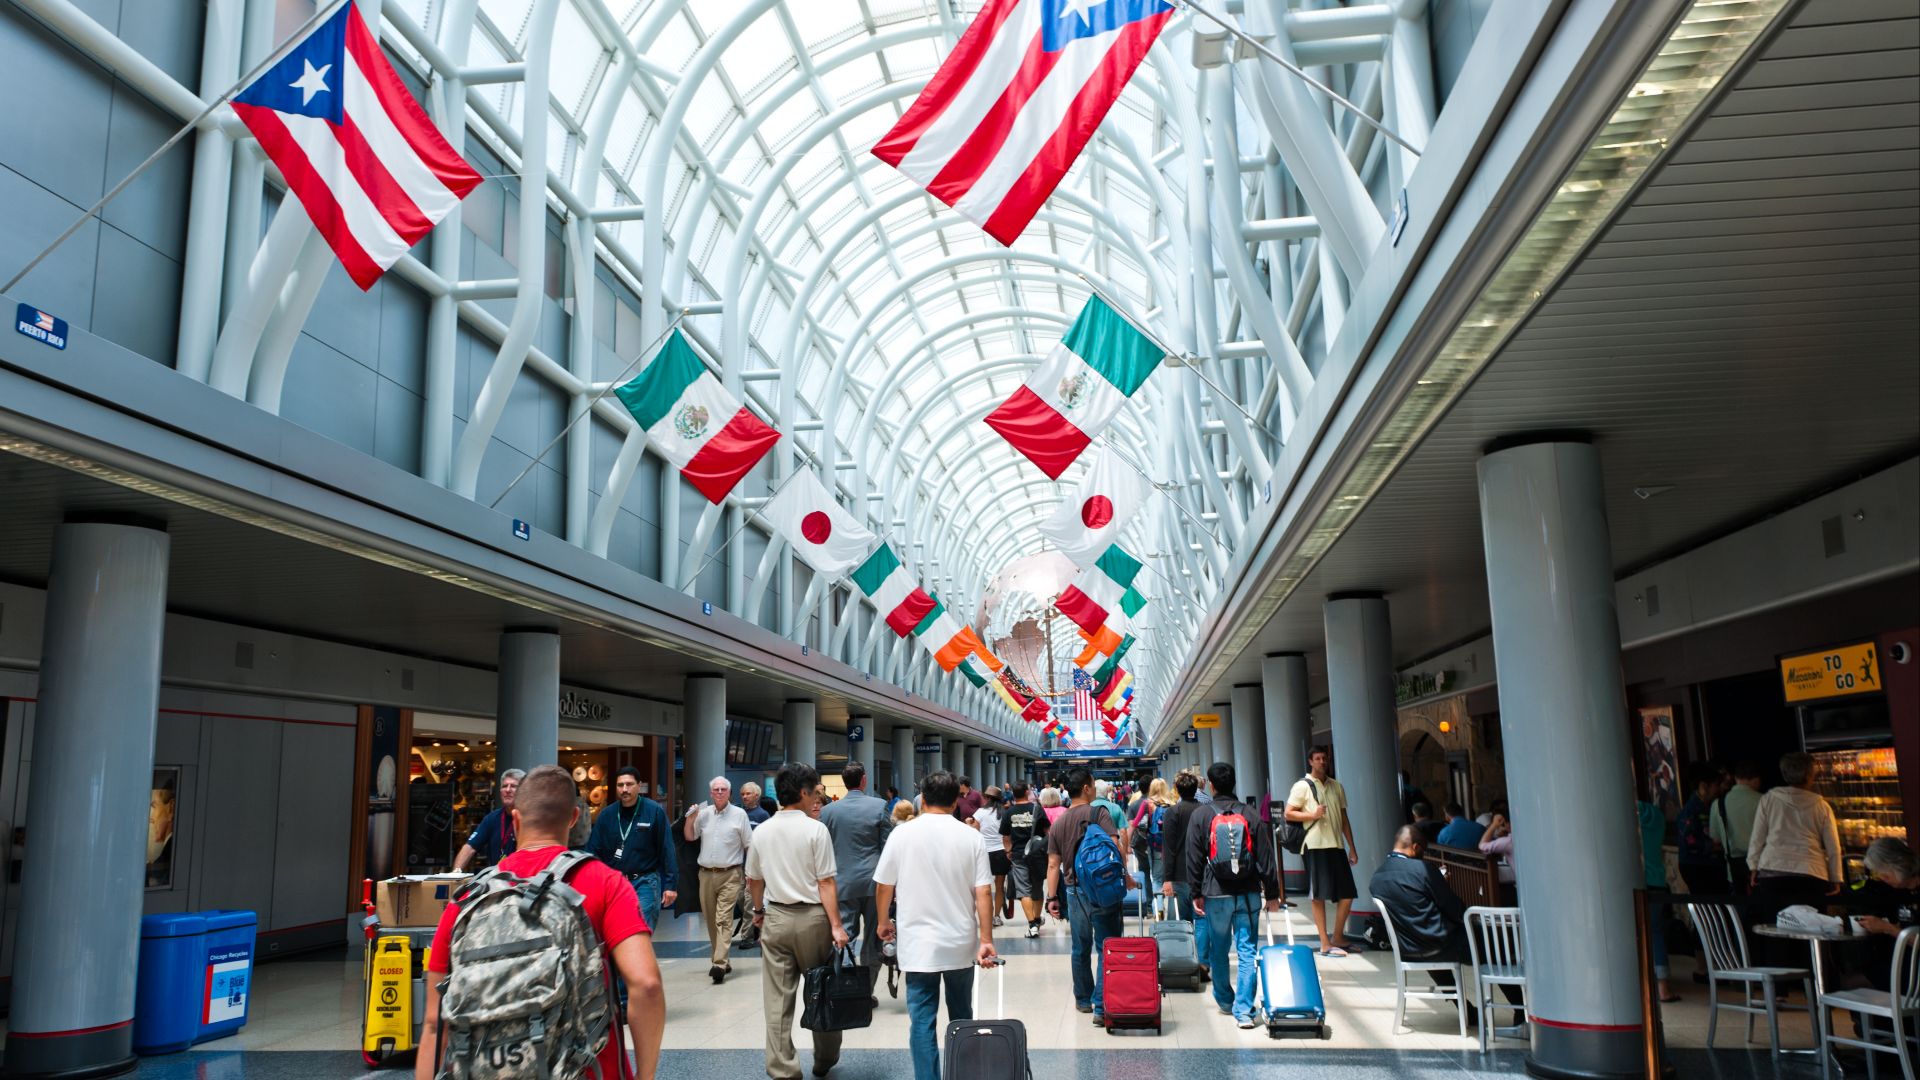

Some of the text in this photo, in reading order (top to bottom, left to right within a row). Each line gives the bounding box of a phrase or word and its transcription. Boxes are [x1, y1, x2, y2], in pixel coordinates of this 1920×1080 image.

[19, 321, 64, 347] PUERTO RICO
[1824, 655, 1842, 672] TO
[1787, 667, 1823, 684] Macaroni
[1835, 673, 1855, 690] GO
[379, 967, 404, 975] CLOSED
[489, 1043, 524, 1070] US
